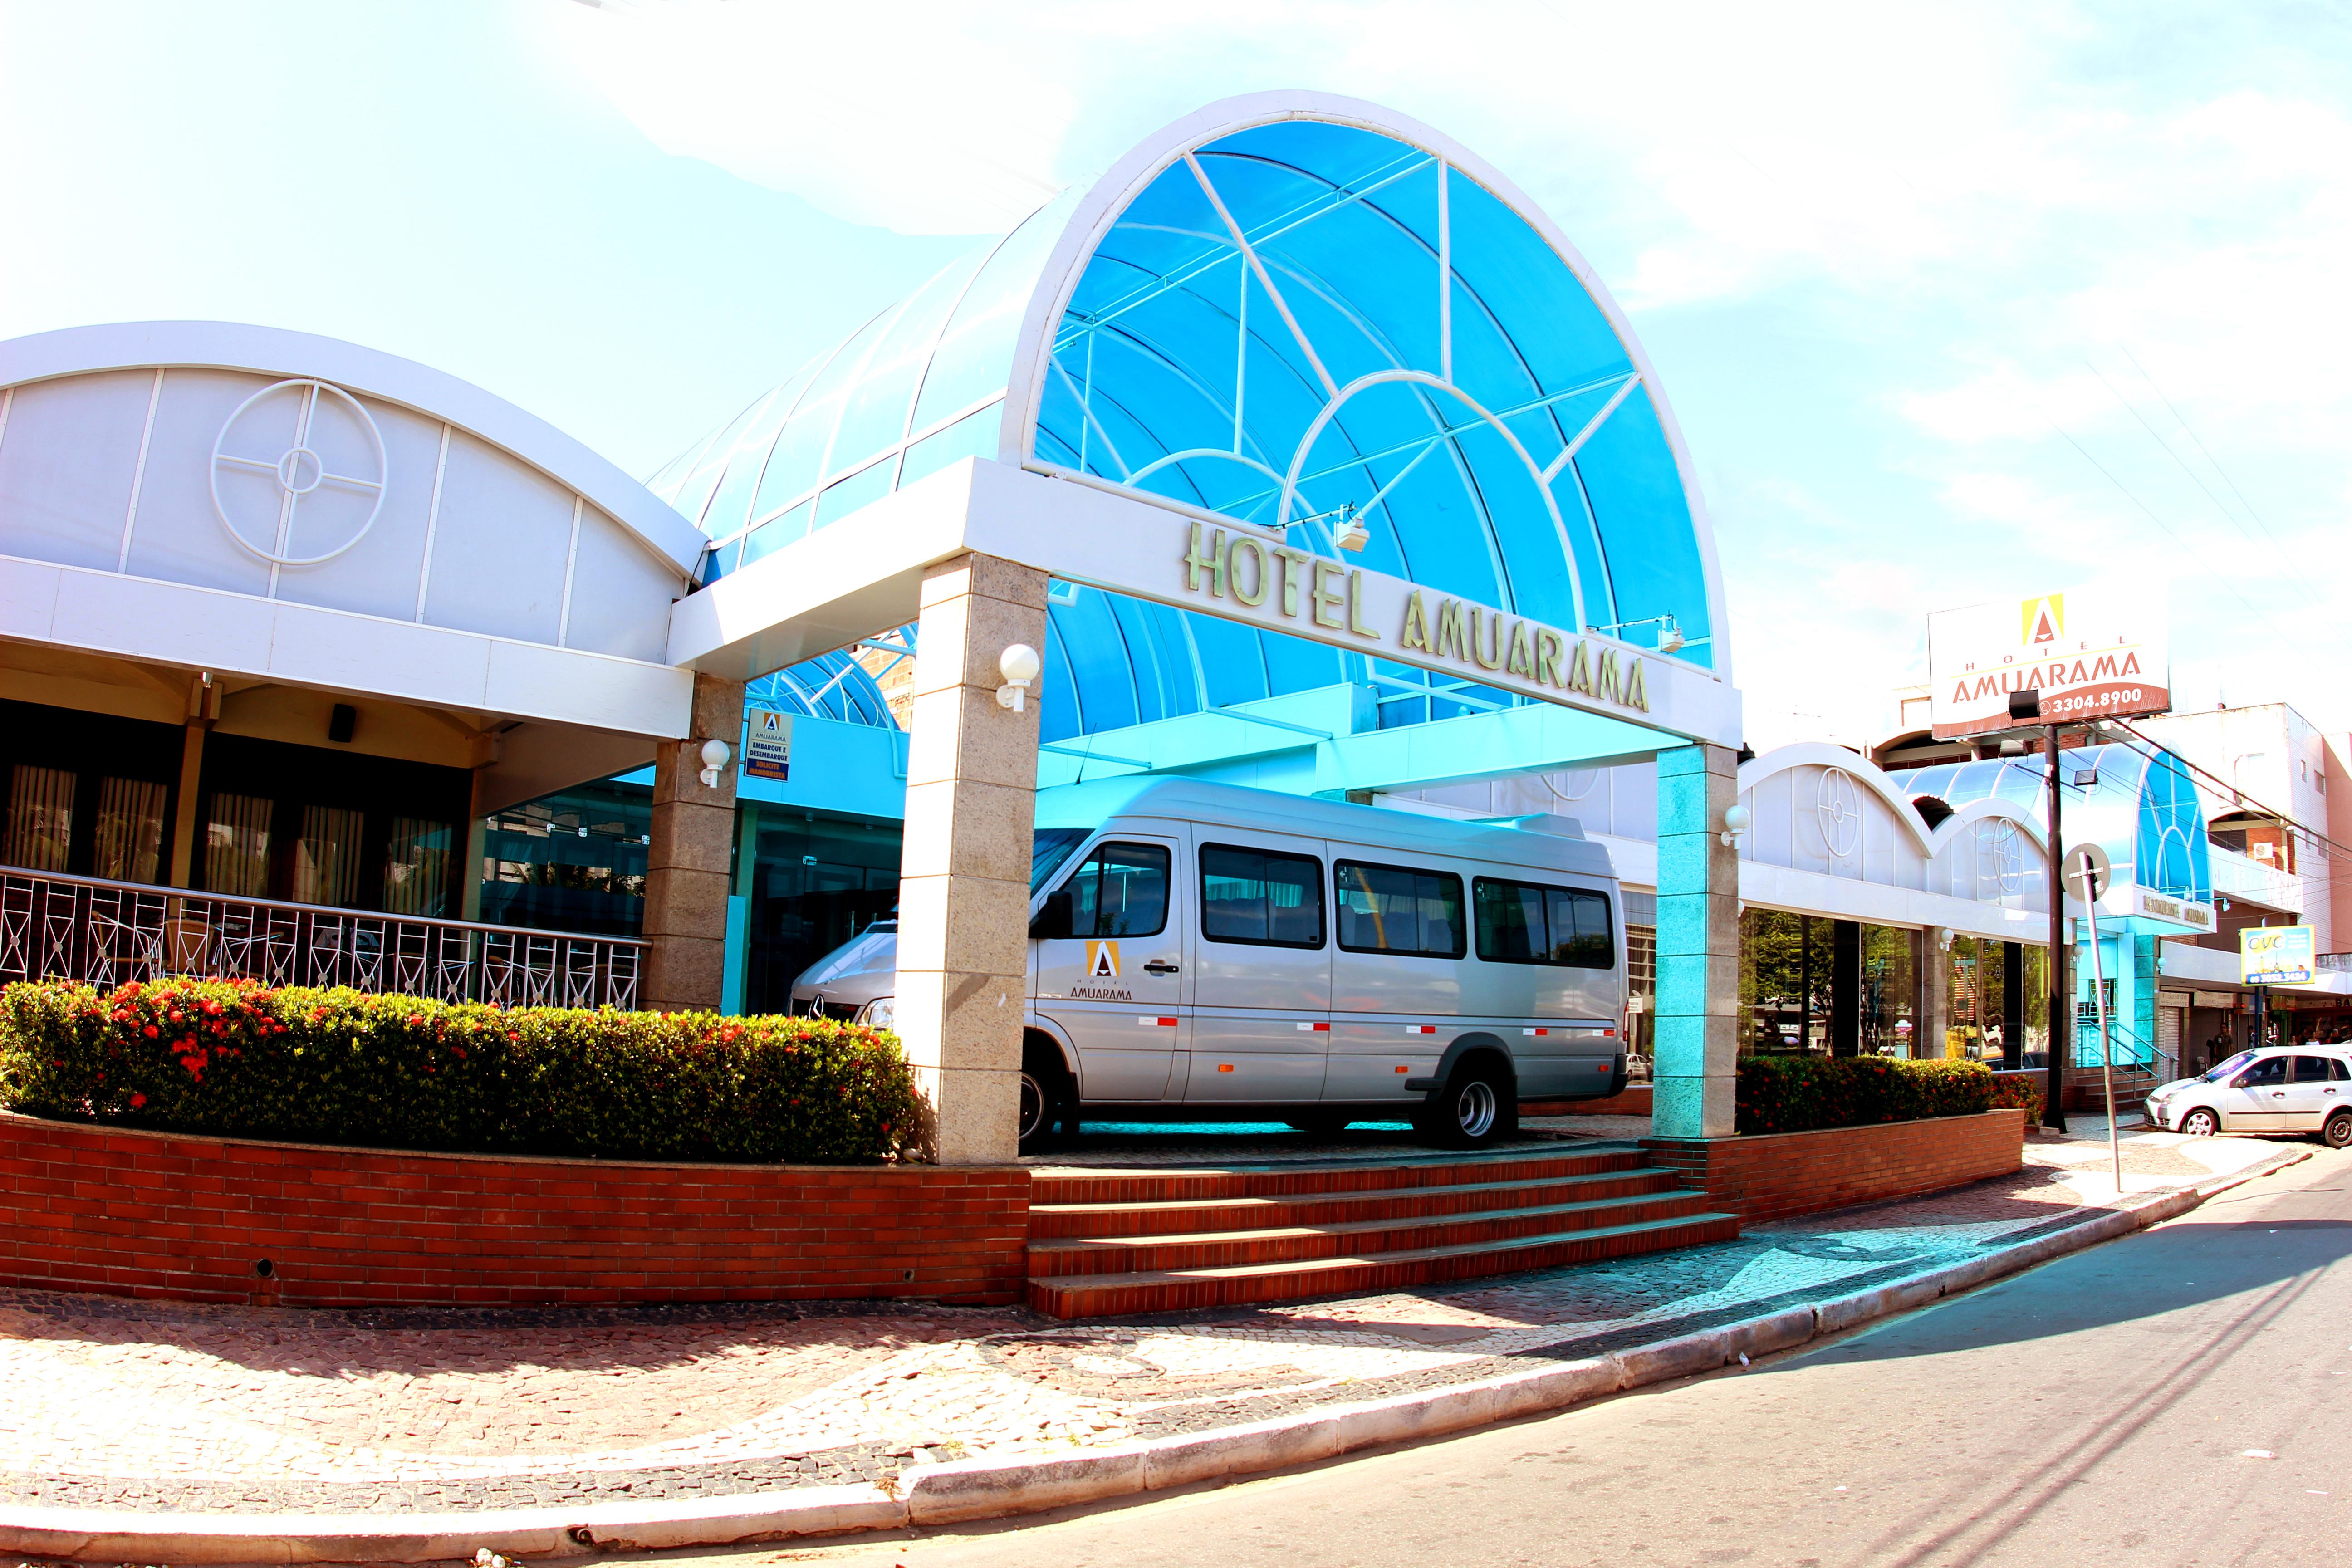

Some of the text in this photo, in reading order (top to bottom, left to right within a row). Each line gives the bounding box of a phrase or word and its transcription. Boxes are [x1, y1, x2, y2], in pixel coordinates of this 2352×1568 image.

[1183, 521, 1651, 714] HOTEL AMUARAMA
[1965, 635, 2126, 671] HOTEL
[1952, 651, 2141, 704] AMUARAMA
[2053, 688, 2142, 713] 3304.8900
[755, 732, 786, 742] AMUARAMA
[753, 742, 782, 752] EMBARQUE
[750, 750, 788, 761] DESEMBARQUE
[756, 760, 779, 770] SOLICITE
[749, 768, 785, 779] MANOBRISTA
[2248, 936, 2283, 950] CVC
[1071, 987, 1132, 1000] AMUARAMA
